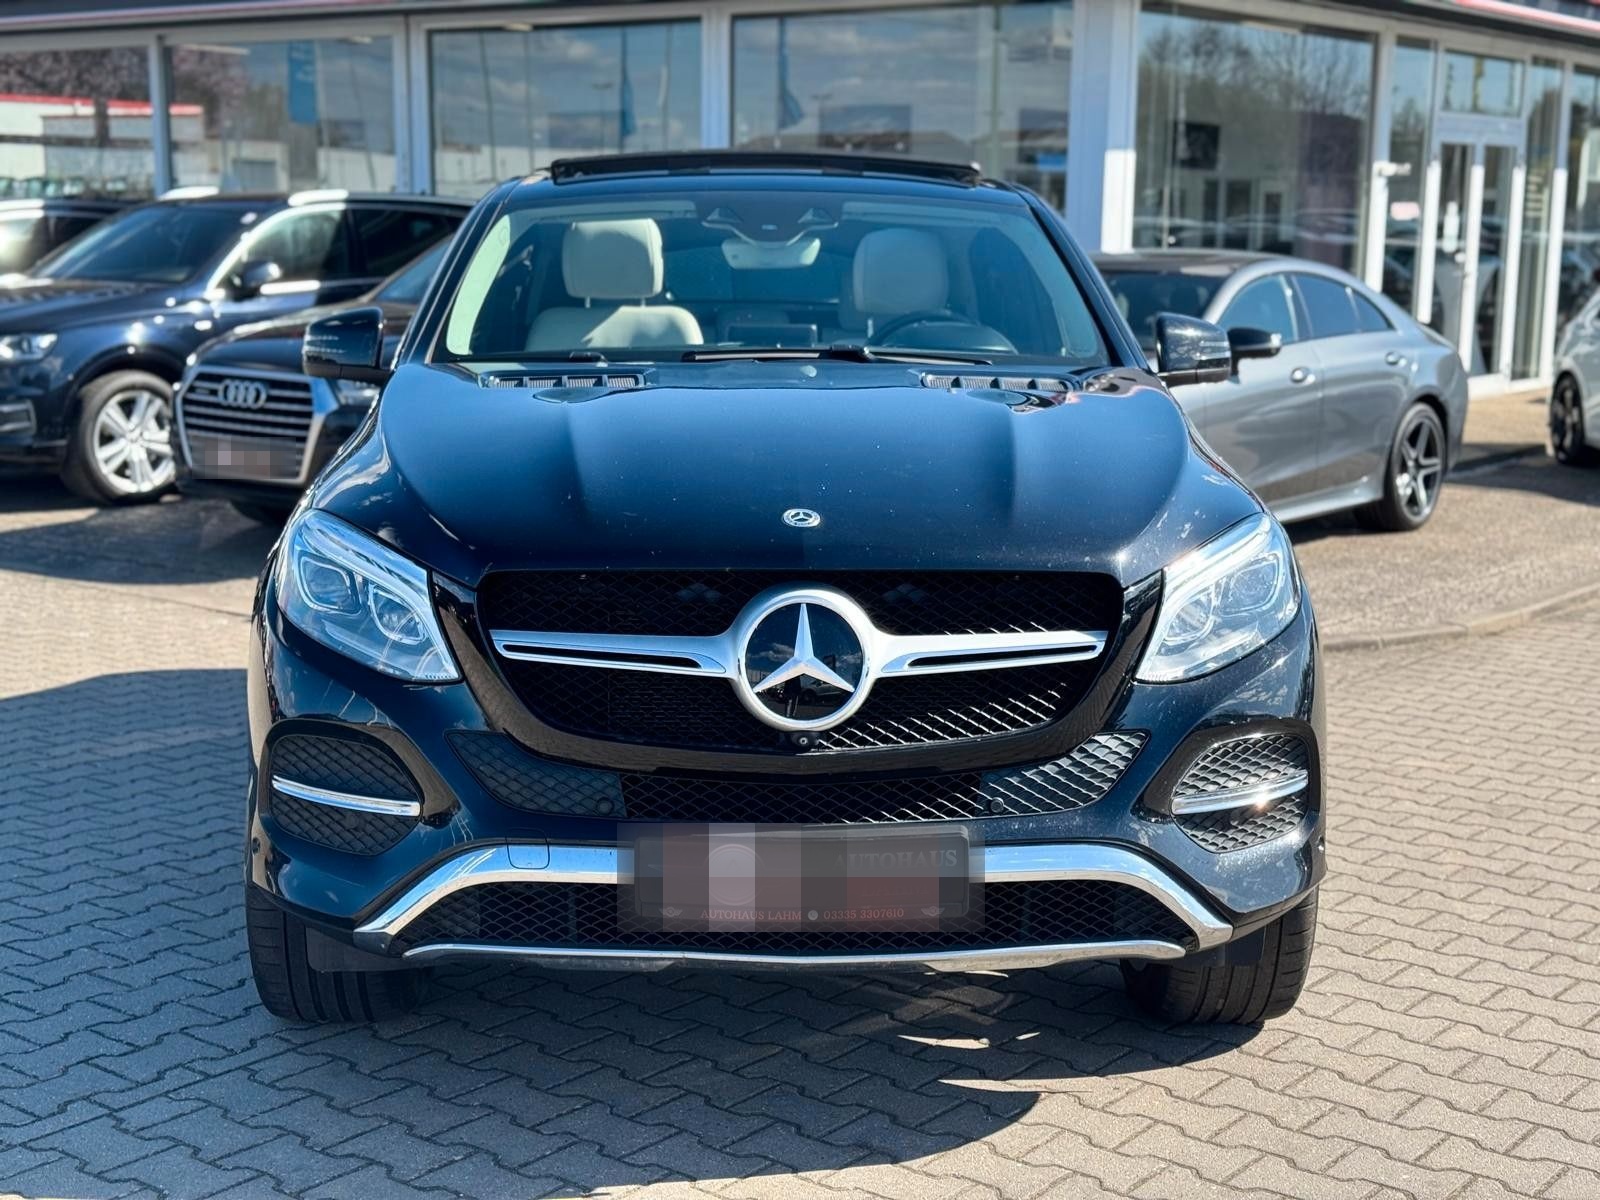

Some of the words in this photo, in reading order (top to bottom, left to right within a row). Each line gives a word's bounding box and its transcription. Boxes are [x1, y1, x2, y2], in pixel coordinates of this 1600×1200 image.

[832, 849, 958, 869] AUTOHAUS
[700, 909, 765, 921] AUTOHAUS
[768, 910, 802, 921] LAHM
[823, 910, 857, 920] 03335
[860, 908, 904, 919] 3307610
